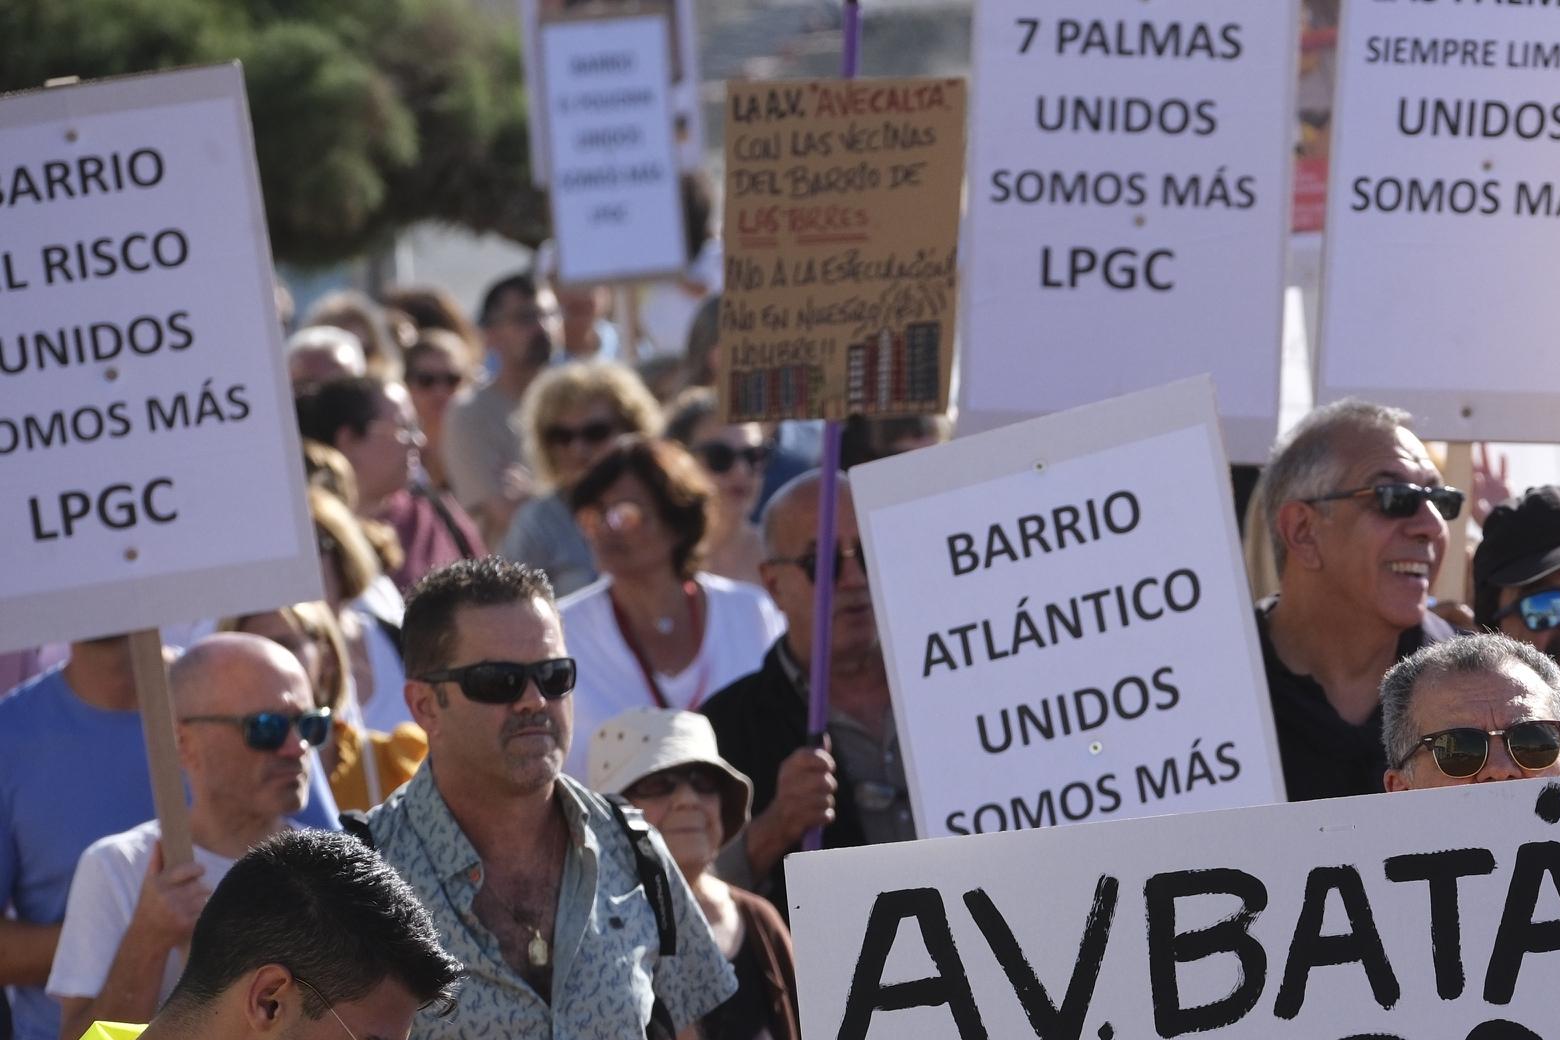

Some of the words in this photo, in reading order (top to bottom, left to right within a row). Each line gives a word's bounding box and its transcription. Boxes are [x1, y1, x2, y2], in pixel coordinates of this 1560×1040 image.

[1015, 18, 1040, 55] 7
[1056, 19, 1243, 60] PALMAS
[1365, 37, 1497, 67] SIEMPRE
[1036, 96, 1217, 135] UNIDOS
[0, 147, 165, 207] ARRIO
[990, 169, 1147, 206] SOMOS
[1161, 166, 1257, 209] MÁS
[1351, 176, 1500, 215] SOMOS
[41, 228, 189, 285] RISCO
[1041, 246, 1176, 291] LPGC
[0, 311, 193, 375] UNIDOS
[0, 402, 131, 456] OMOS
[146, 378, 250, 432] MÁS
[29, 477, 178, 541] LPGC
[947, 490, 1141, 576] BARRIO
[922, 568, 1201, 678] ATLÁNTICO
[976, 666, 1180, 754] UNIDOS
[945, 774, 1121, 836] SOMOS
[1135, 738, 1241, 804] MÁS
